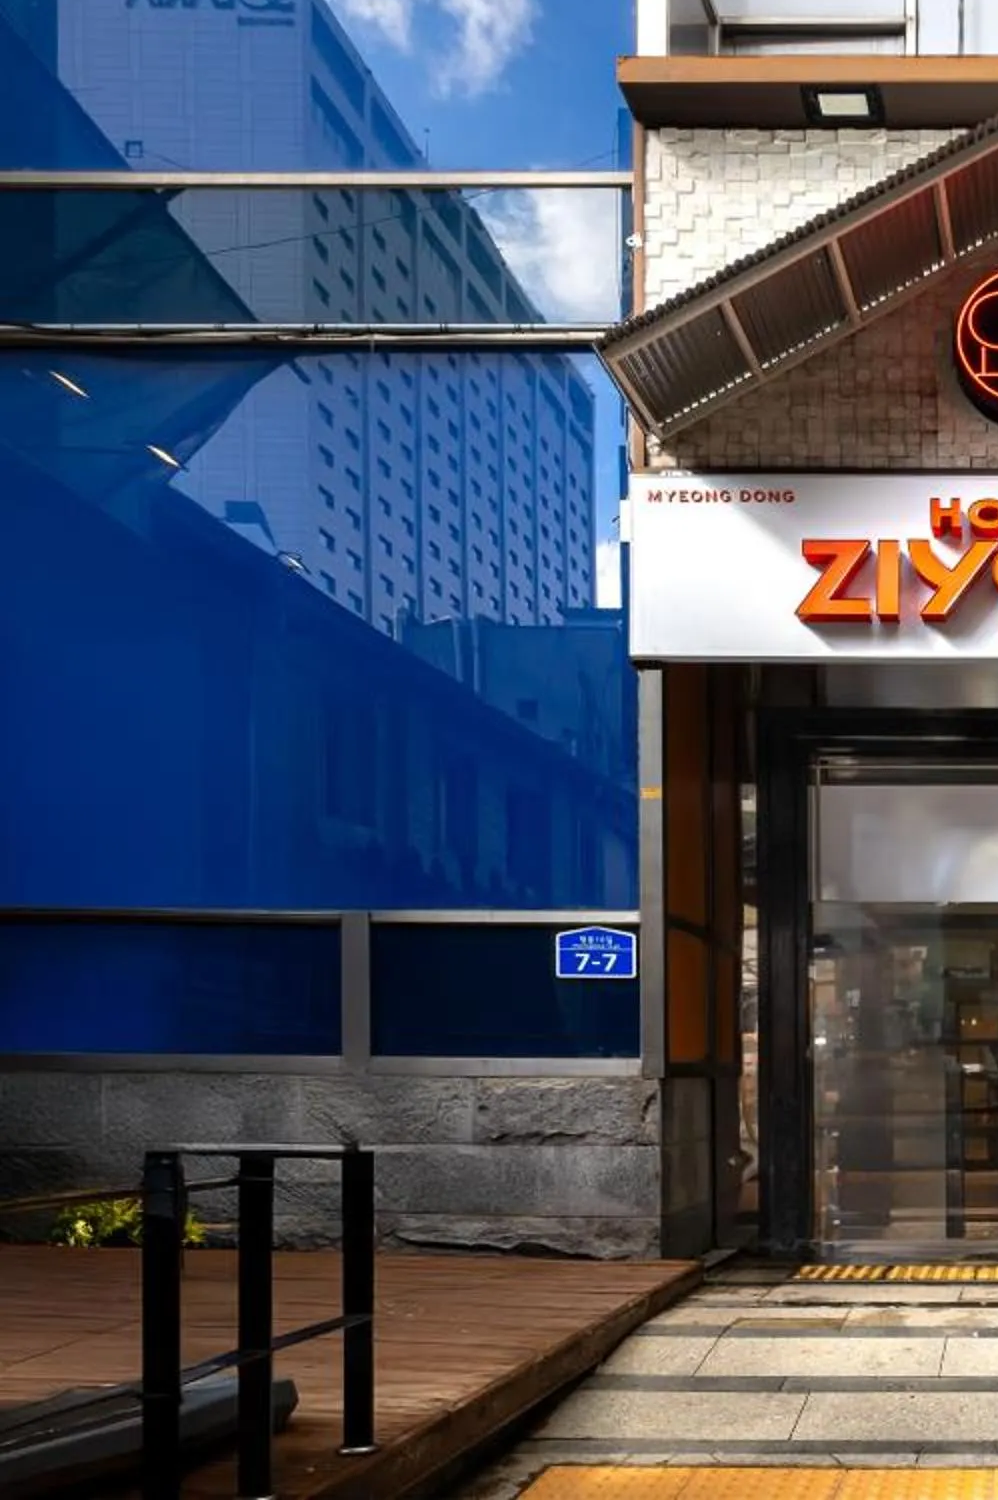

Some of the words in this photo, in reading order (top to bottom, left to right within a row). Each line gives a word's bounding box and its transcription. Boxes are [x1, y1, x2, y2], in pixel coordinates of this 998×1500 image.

[647, 489, 732, 503] MYEONG
[739, 489, 796, 503] DONG
[575, 952, 617, 972] 7-7
